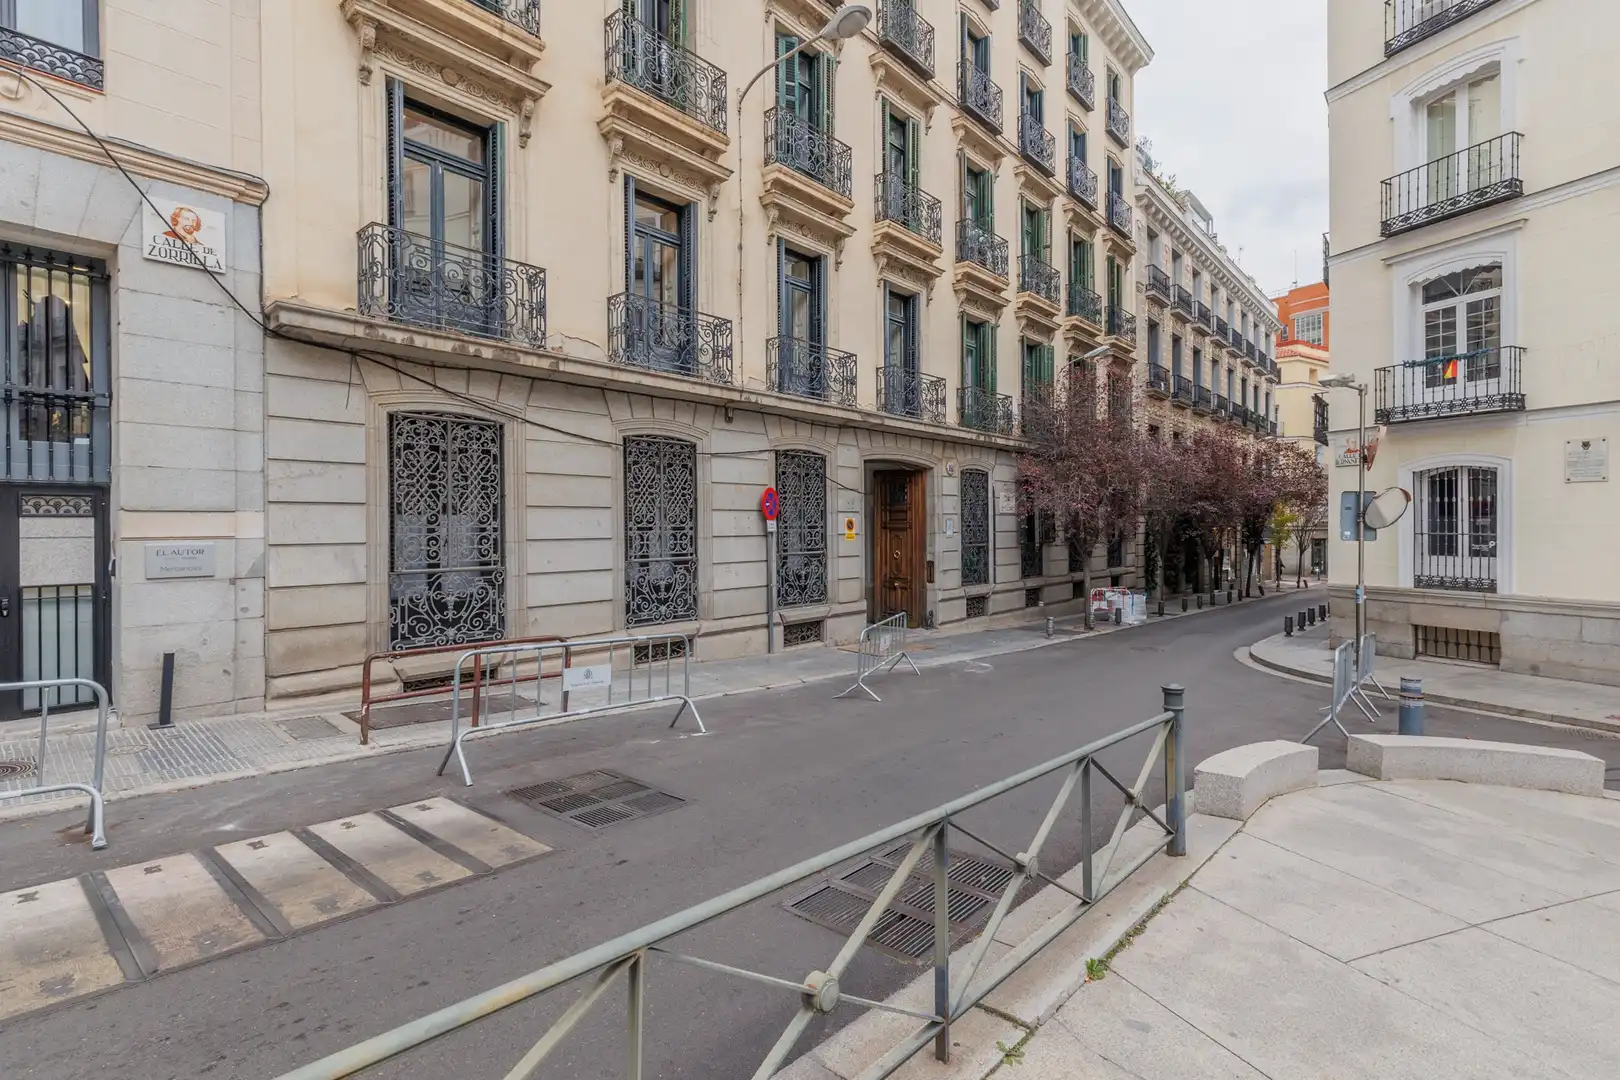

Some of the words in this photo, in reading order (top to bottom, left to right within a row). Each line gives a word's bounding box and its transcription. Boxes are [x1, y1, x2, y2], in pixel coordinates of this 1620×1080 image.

[153, 235, 199, 253] CALLE
[203, 246, 218, 256] DE
[148, 244, 223, 269] ZORRILLA
[171, 548, 205, 556] AUTOR
